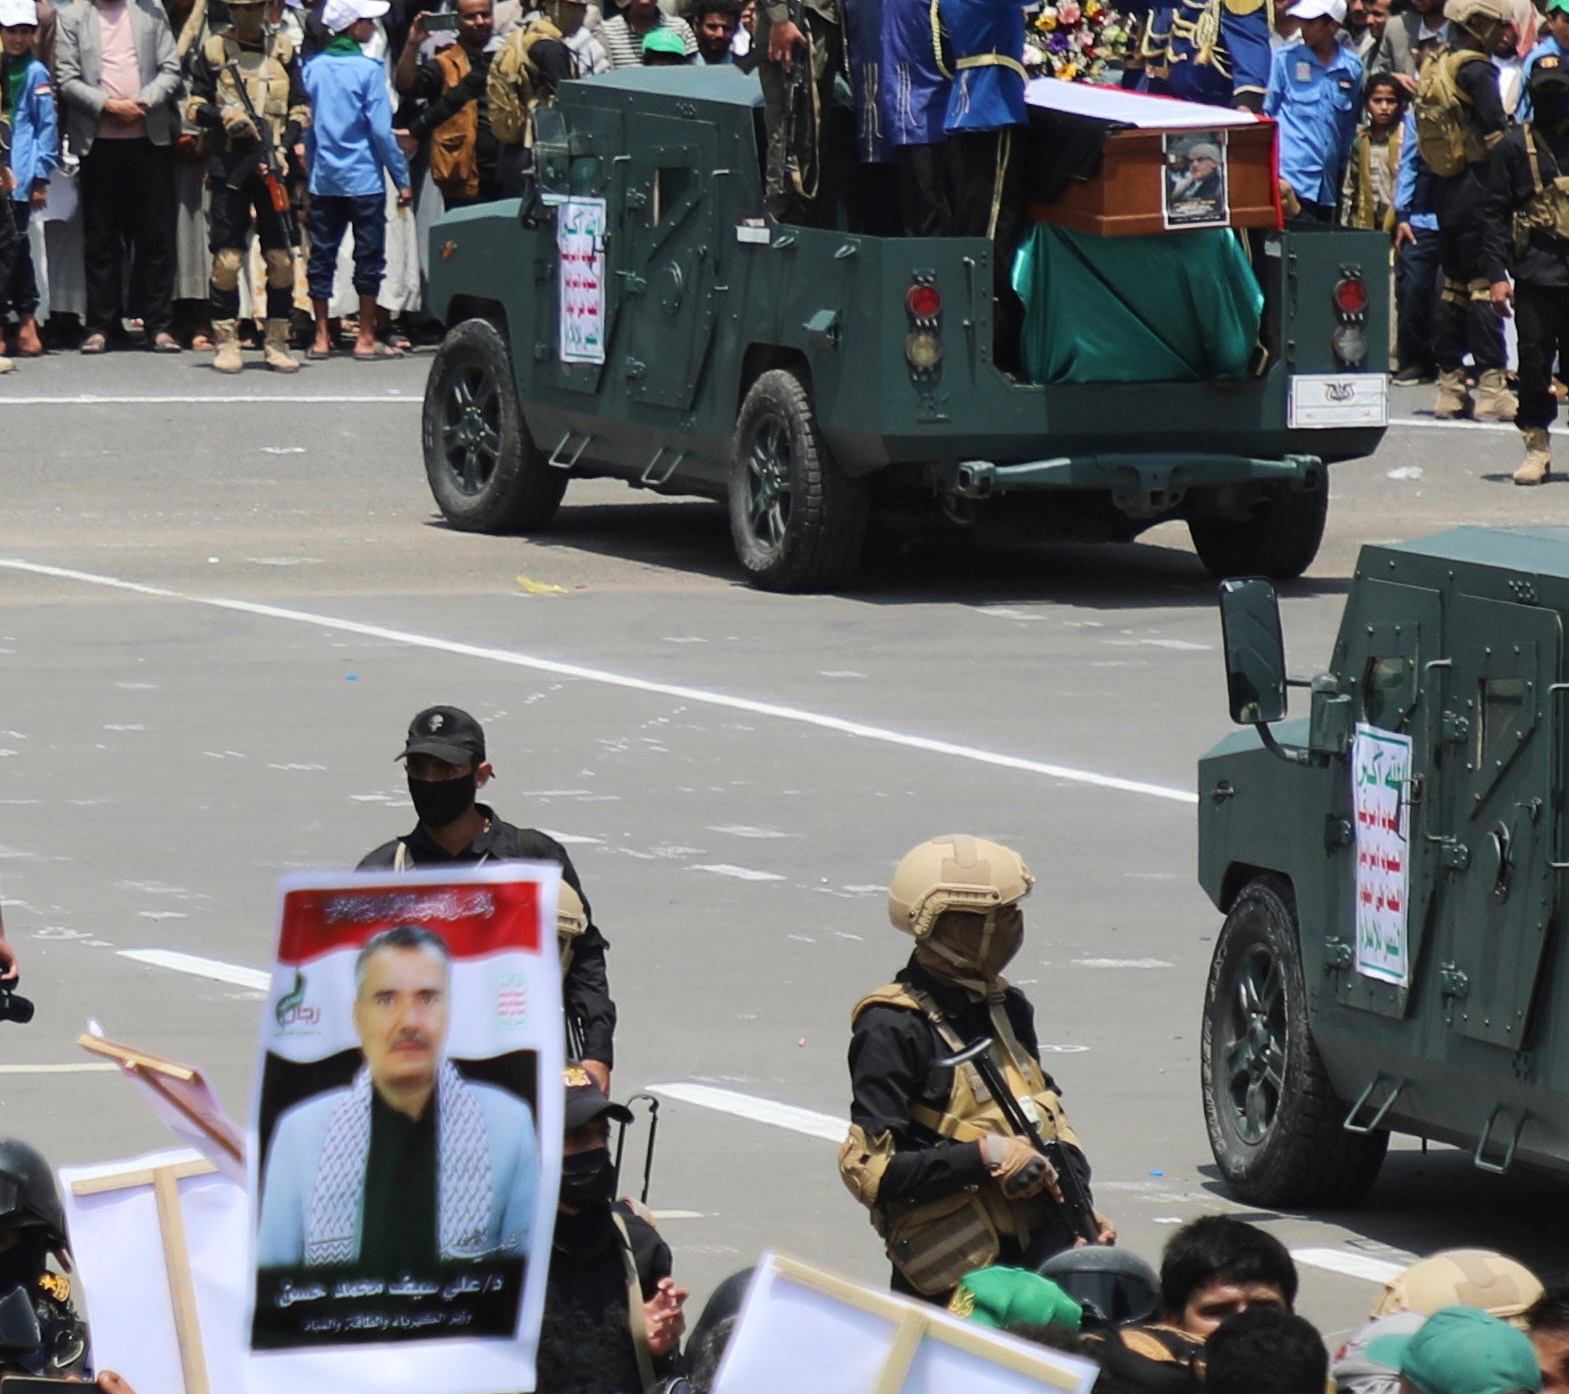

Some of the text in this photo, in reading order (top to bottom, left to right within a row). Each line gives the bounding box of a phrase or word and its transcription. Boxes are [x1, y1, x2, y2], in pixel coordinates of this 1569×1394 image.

[278, 1284, 327, 1307] حسن
[334, 1282, 384, 1299] محمد
[388, 1275, 440, 1300] سيف
